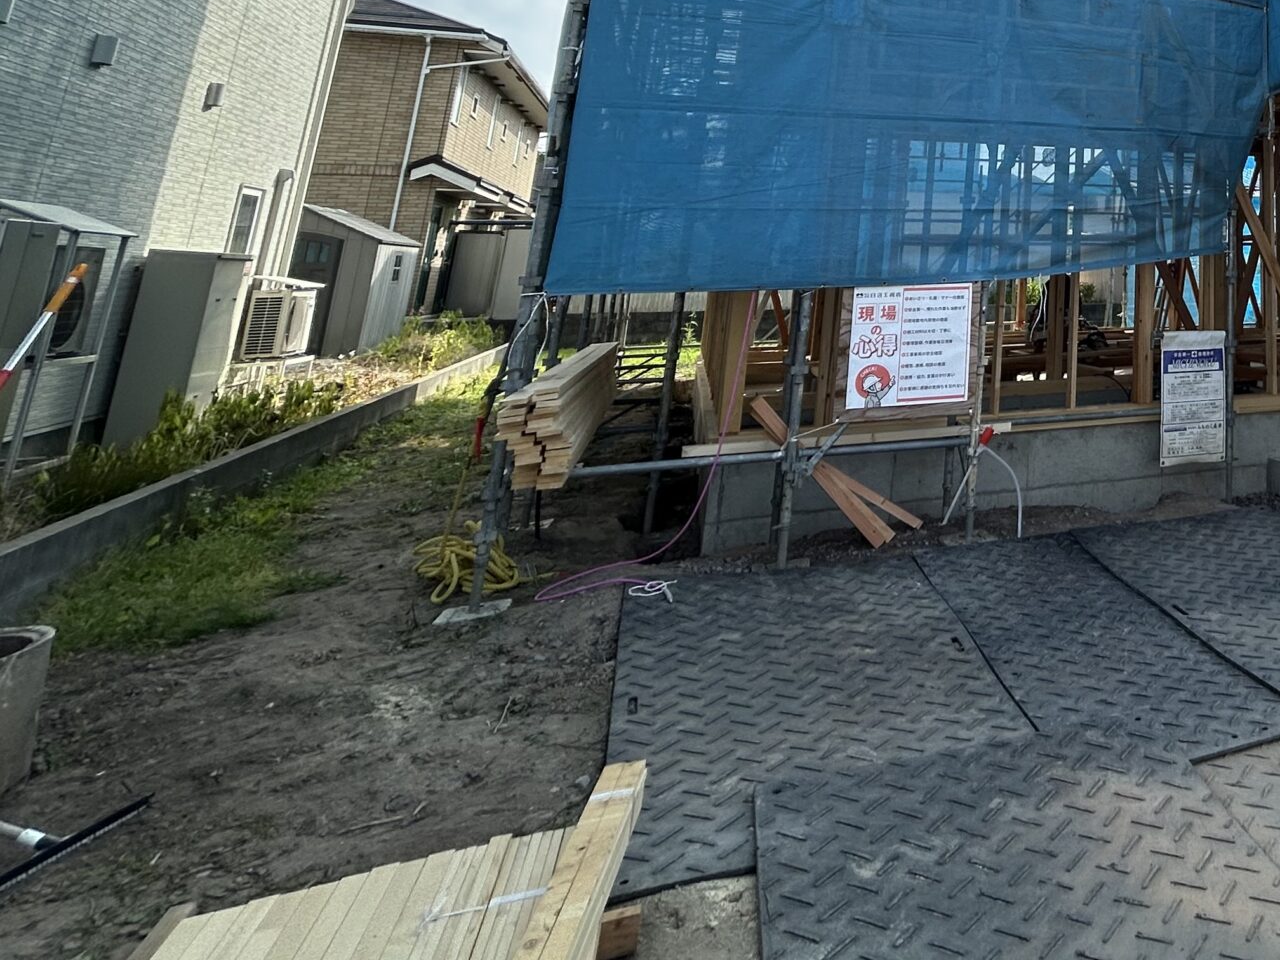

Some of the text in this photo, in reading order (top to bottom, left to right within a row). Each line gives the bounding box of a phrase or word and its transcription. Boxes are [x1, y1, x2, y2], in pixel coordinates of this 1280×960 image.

[857, 305, 896, 321] 現場
[871, 325, 881, 335] の
[852, 334, 897, 358] 心得
